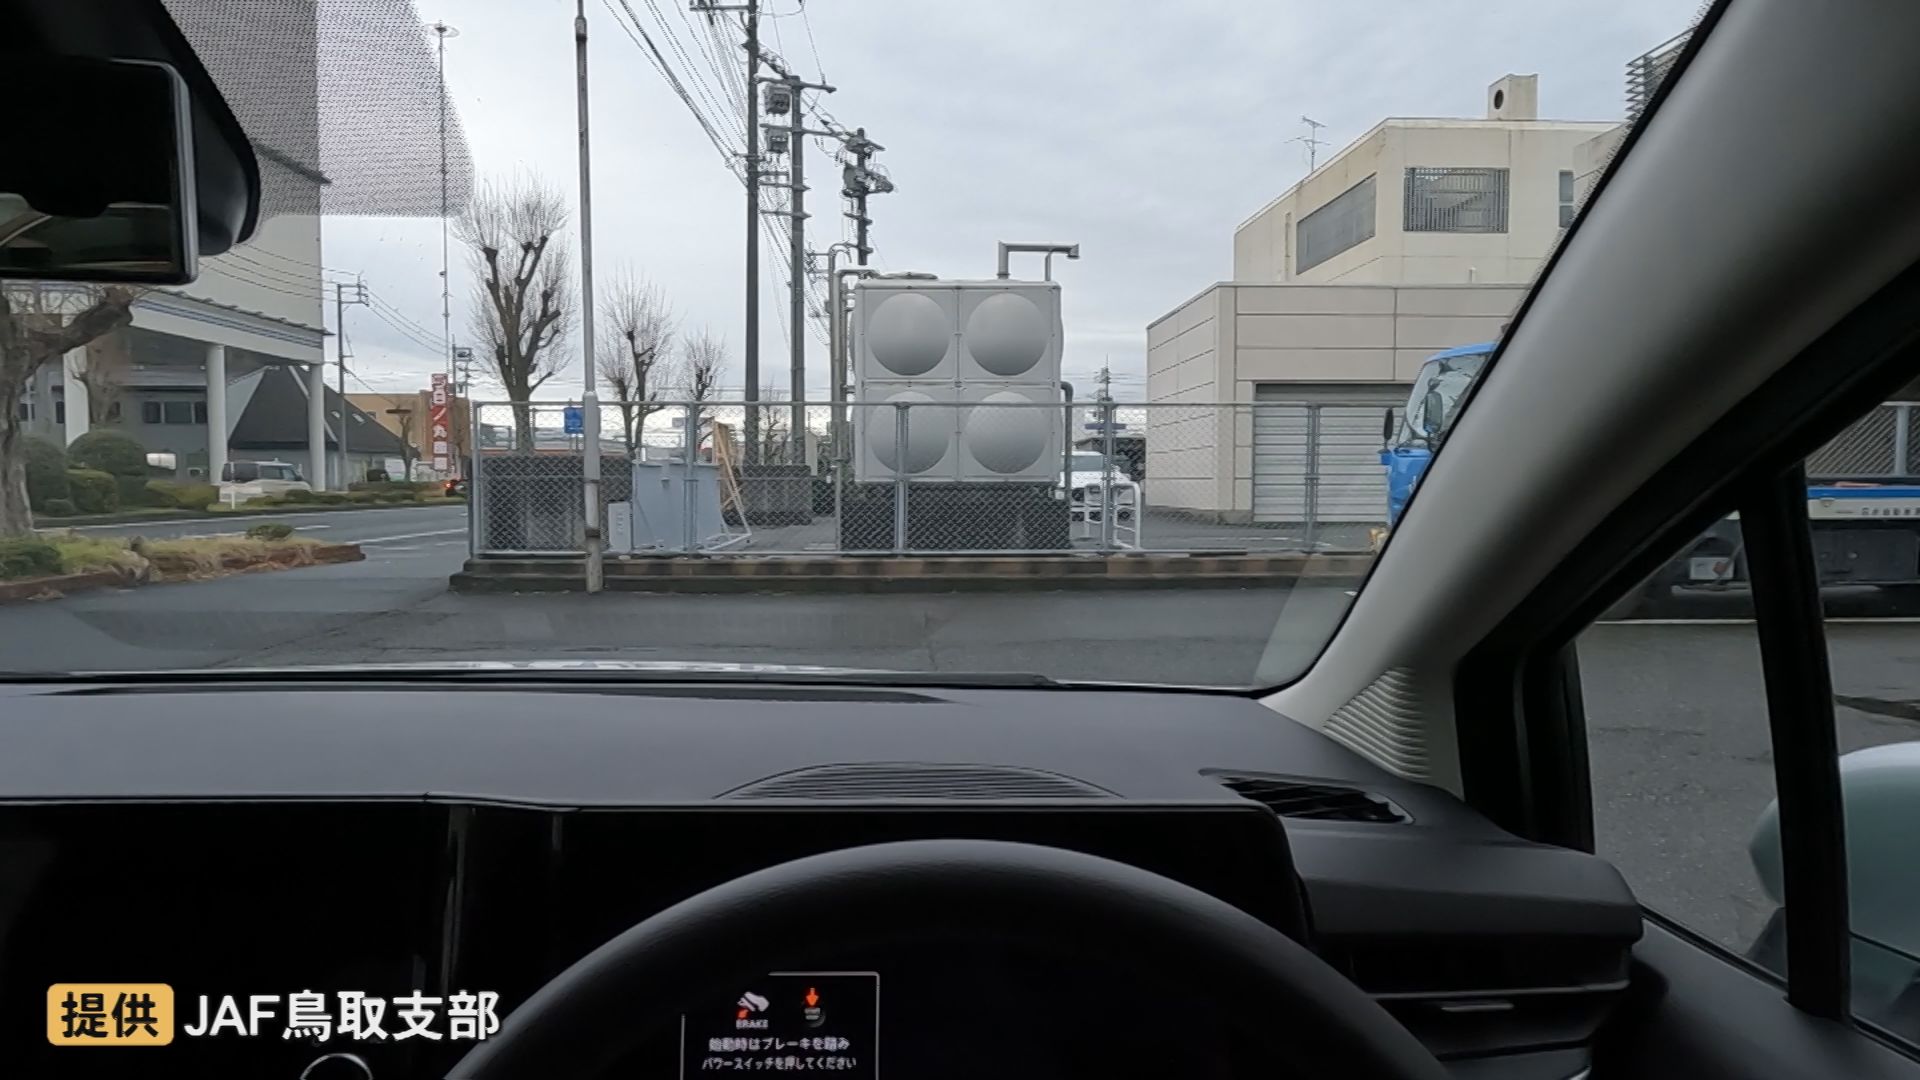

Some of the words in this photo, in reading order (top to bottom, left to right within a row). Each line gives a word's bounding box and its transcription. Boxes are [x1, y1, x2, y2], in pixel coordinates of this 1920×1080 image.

[702, 1056, 856, 1070] パワースイッチを押してください
